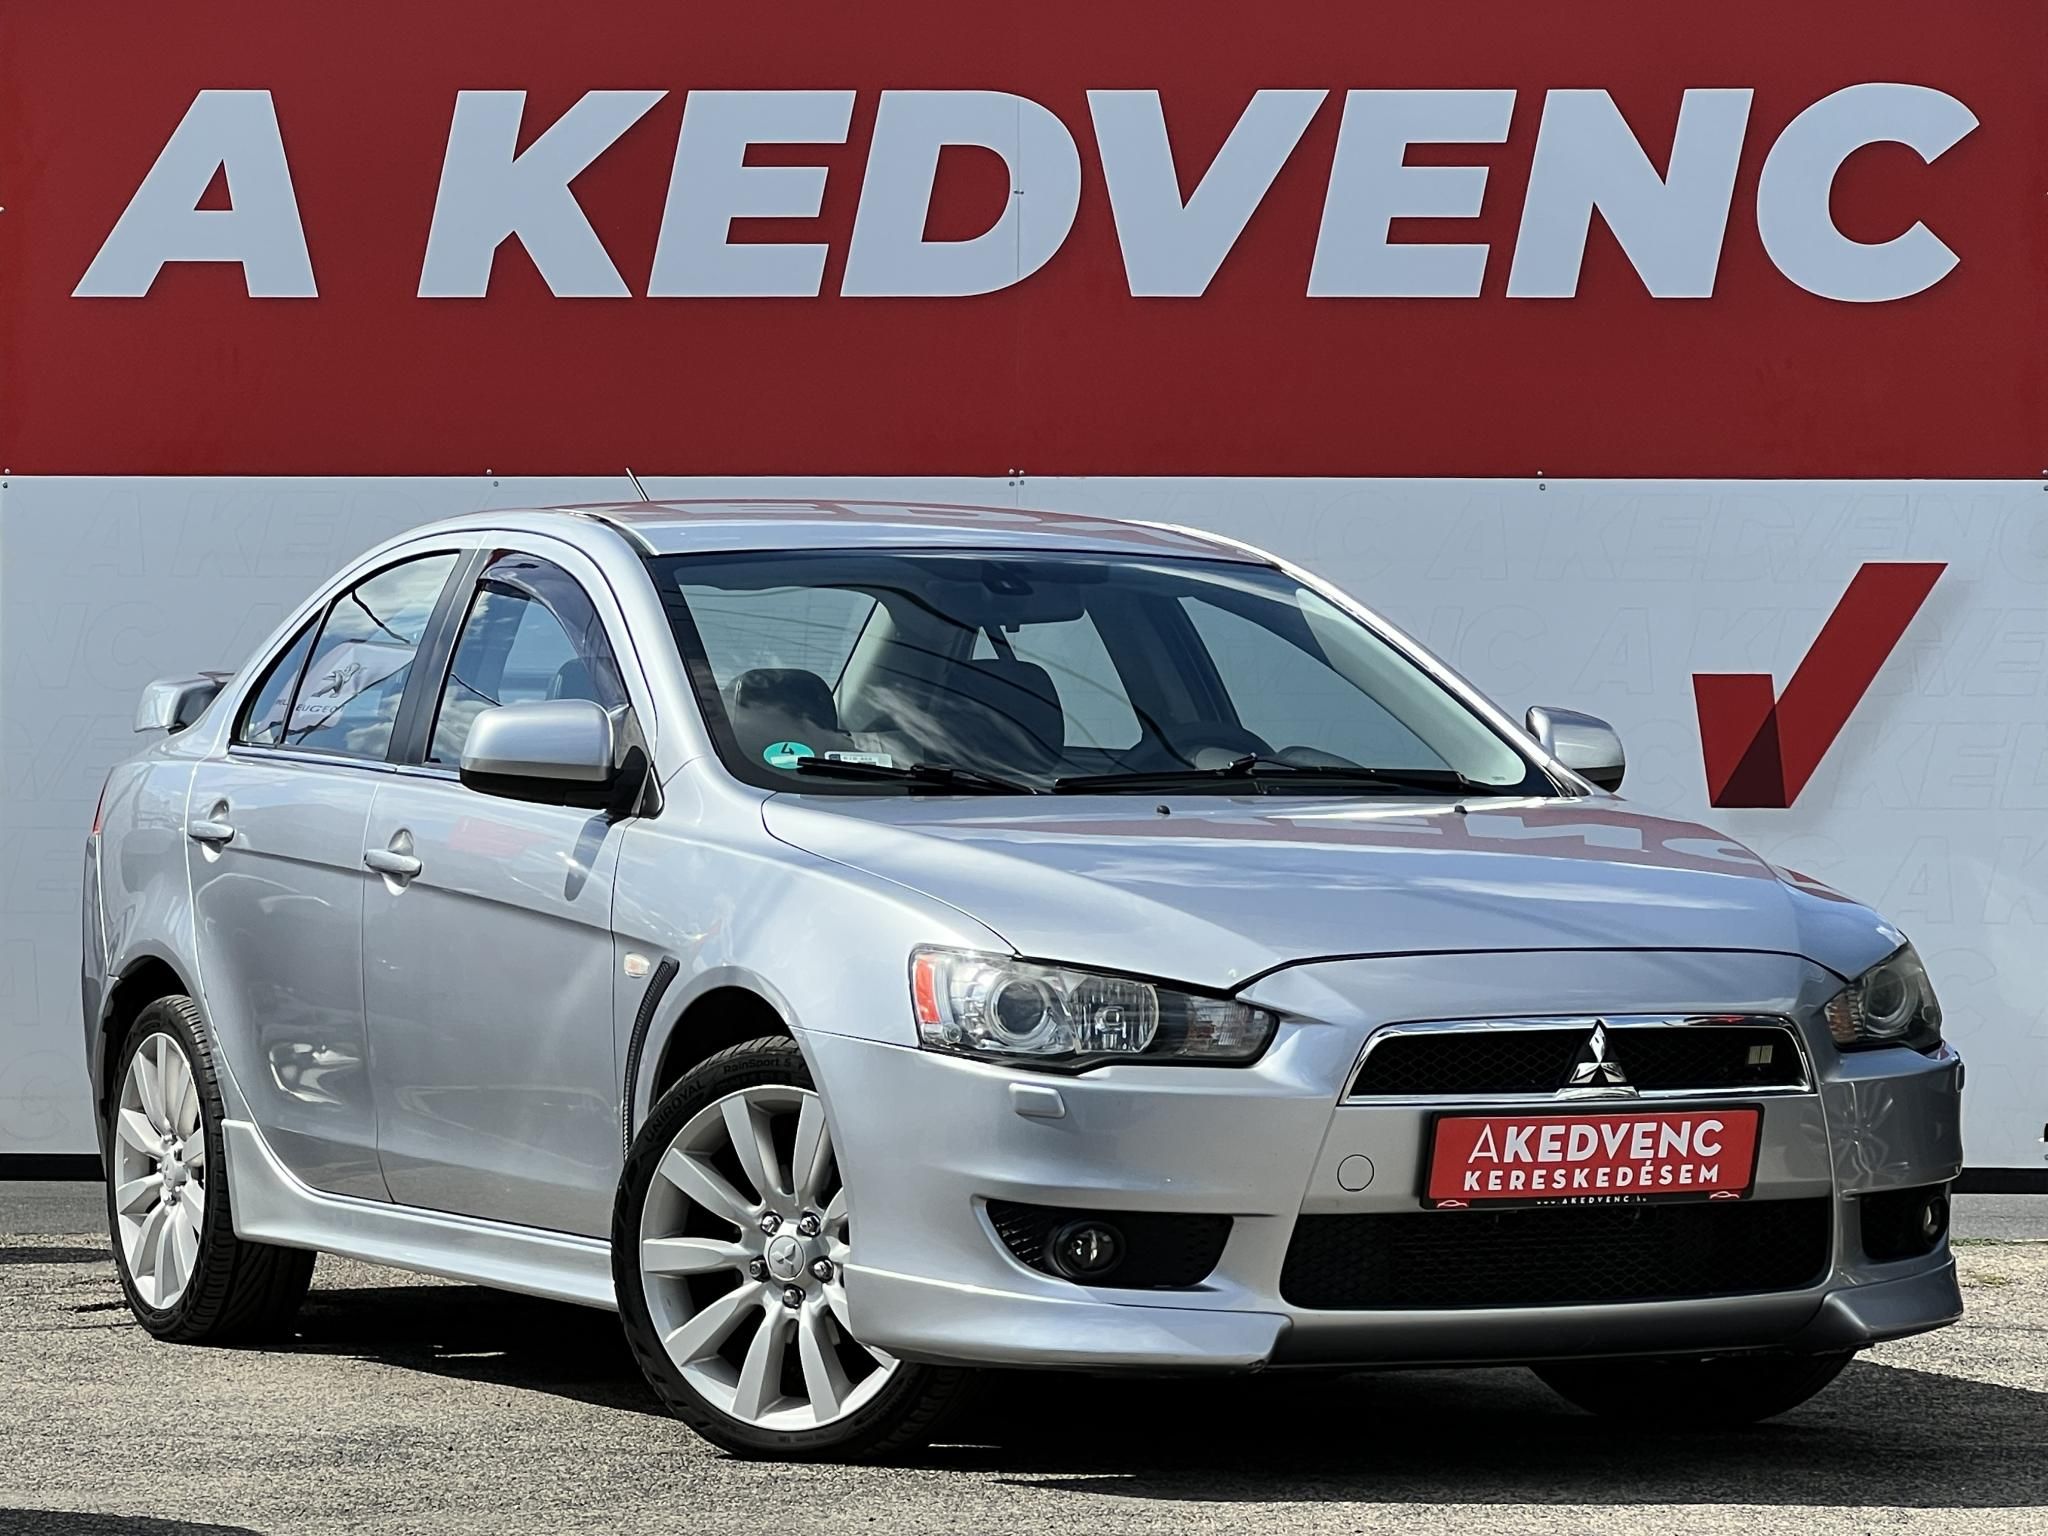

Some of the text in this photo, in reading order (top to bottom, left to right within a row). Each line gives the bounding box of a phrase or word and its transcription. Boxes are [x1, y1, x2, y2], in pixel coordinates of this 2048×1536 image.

[71, 83, 1979, 302] A KEDVENC
[781, 743, 795, 755] 4
[723, 1058, 780, 1075] RainSport
[644, 1079, 707, 1143] UNIROYAL
[1463, 1160, 1720, 1192] KERESKEDÉSEM
